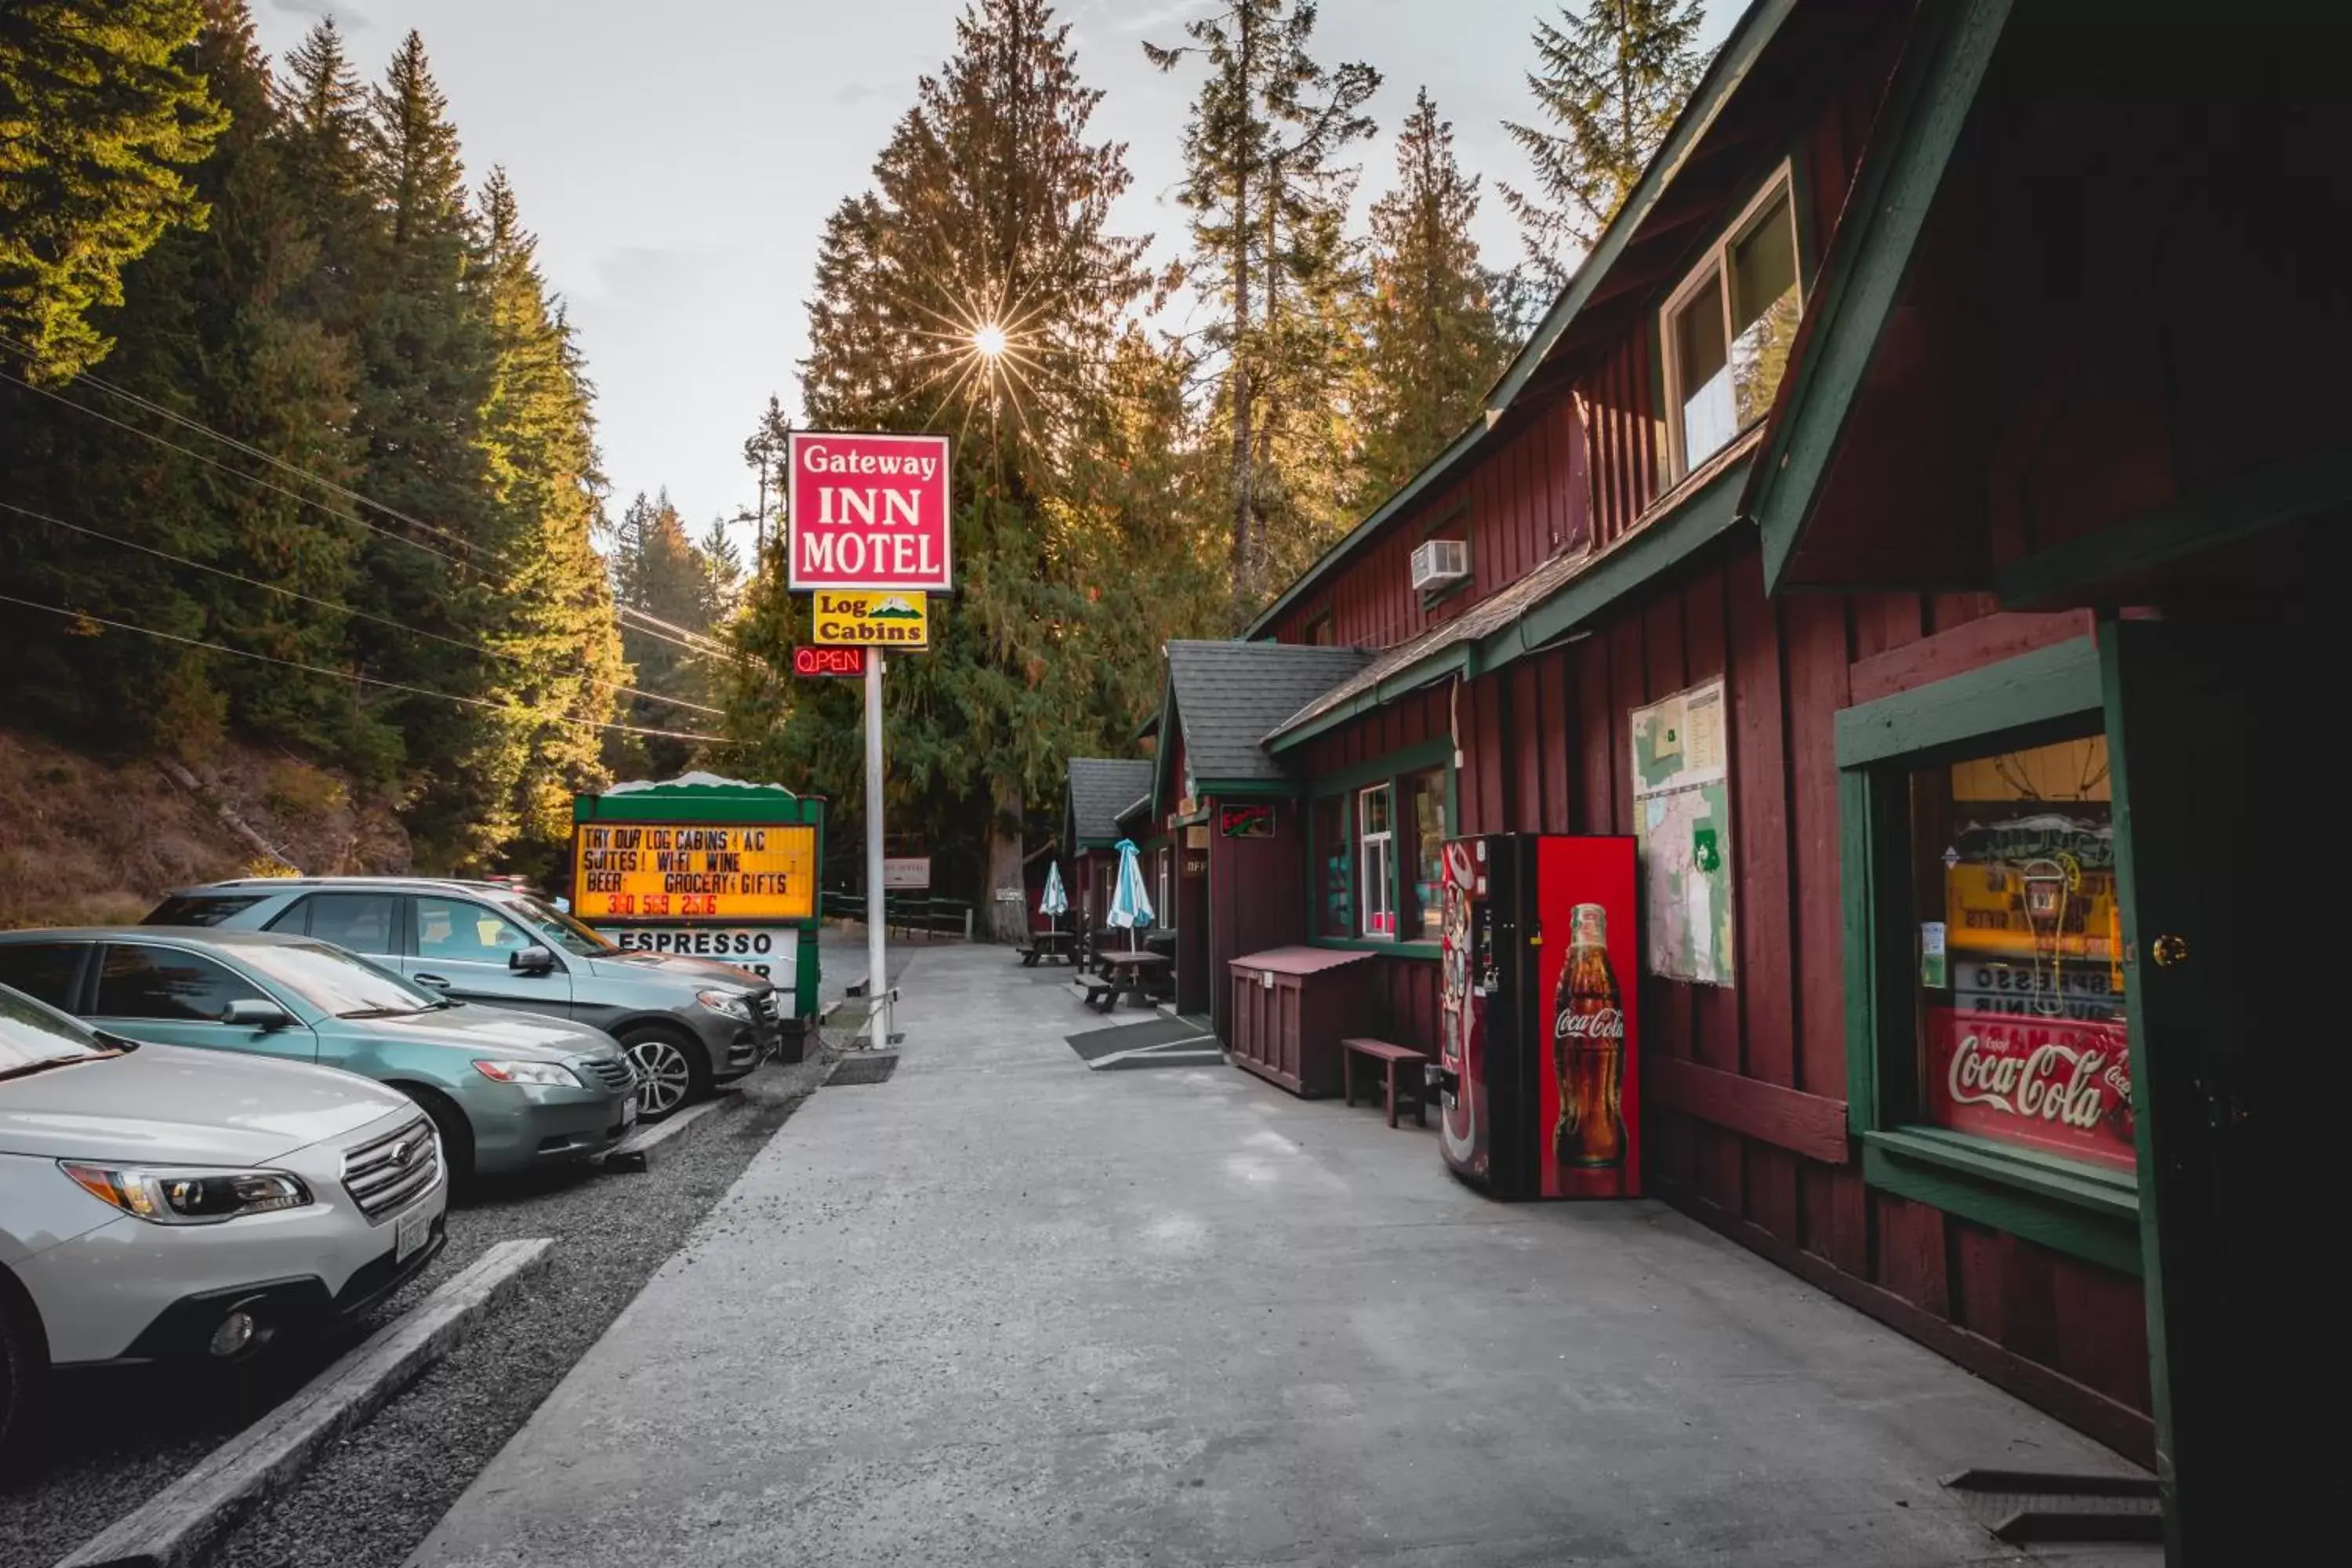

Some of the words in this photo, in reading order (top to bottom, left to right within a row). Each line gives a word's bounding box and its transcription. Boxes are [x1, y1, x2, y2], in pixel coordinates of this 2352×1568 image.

[804, 445, 937, 481] Gateway
[818, 487, 921, 526] INN
[802, 532, 940, 574] MOTEL
[820, 596, 867, 618] Log
[819, 622, 921, 641] Cabins
[797, 650, 859, 673] OPEN
[584, 829, 610, 848] TRY
[615, 829, 641, 849] OUR
[646, 830, 671, 849] LOG
[676, 831, 728, 850] CABINS
[707, 853, 740, 872] WINE
[587, 873, 621, 891] BEER
[665, 874, 728, 893] GROCERY
[741, 874, 786, 894] GIFTS
[619, 933, 771, 954] ESPRESSO
[1555, 1007, 1624, 1039] Coca-Cola
[1948, 1035, 2107, 1128] Coca-Cola
